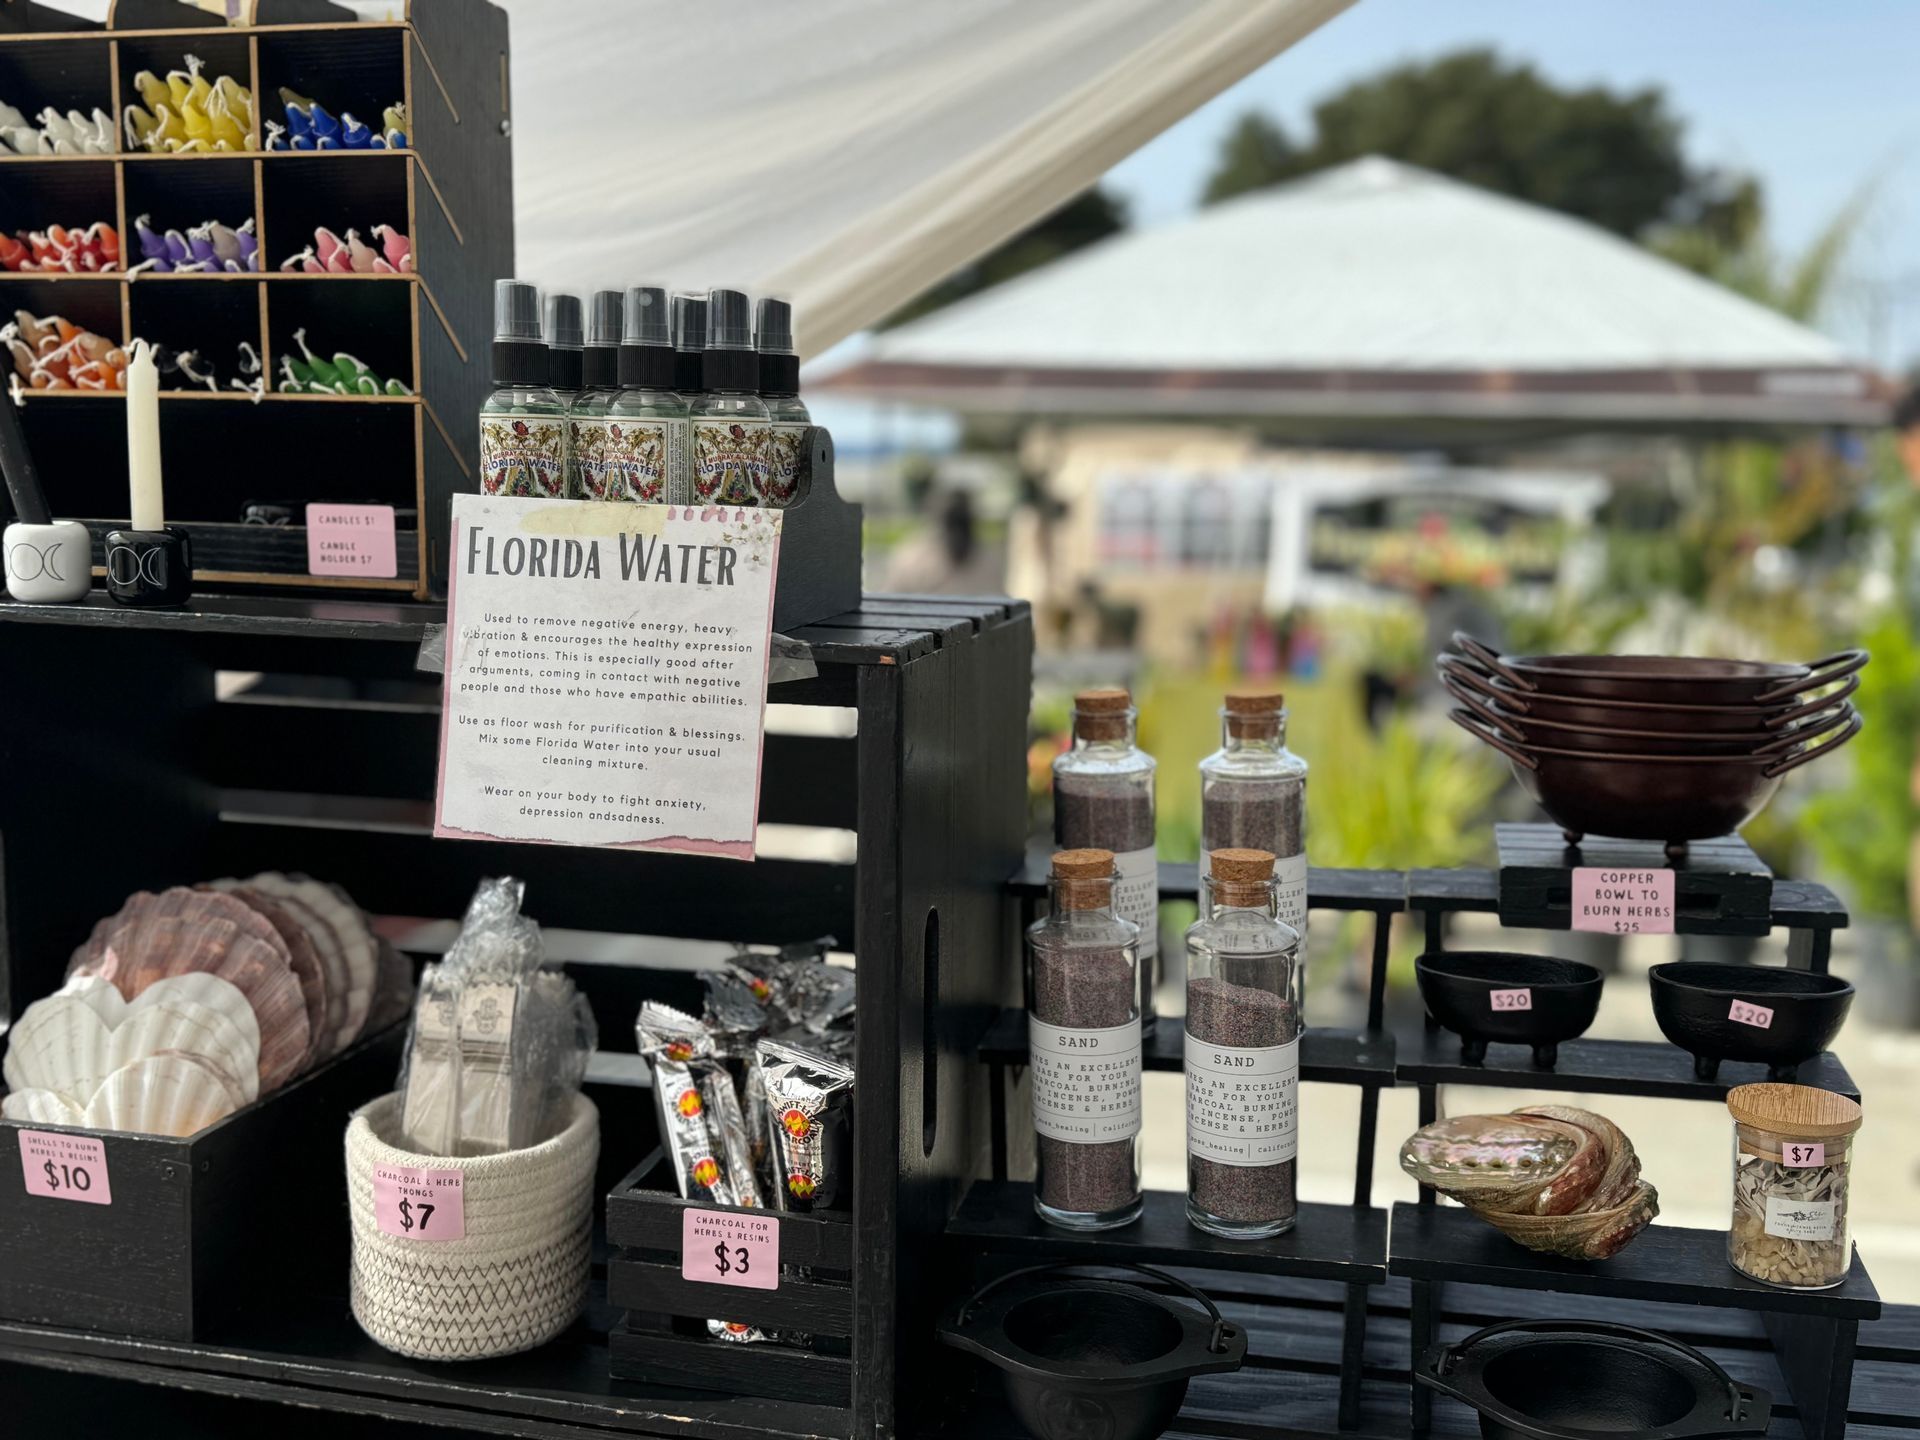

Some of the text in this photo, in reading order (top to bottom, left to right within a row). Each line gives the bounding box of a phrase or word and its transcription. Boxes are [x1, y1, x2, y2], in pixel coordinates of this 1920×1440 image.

[580, 461, 605, 473] WATE
[622, 461, 658, 478] WATER
[698, 461, 769, 476] FLORIDA WATE
[774, 466, 800, 480] FLOR
[318, 515, 361, 525] CANDLES
[320, 542, 356, 551] CANDLE
[320, 555, 356, 563] HOLDER
[484, 613, 733, 636] Used to remove negative energy, heavy
[462, 629, 753, 653] vibration & encourages the healthy expression
[478, 648, 734, 670] of emotions. This is especially good after
[469, 666, 741, 688] arguments, coming in contact with negative
[460, 682, 748, 706] people and those who have empathic abilities.
[459, 714, 745, 742] Use as floor wash for purification & blessings.
[479, 733, 721, 758] Mix some Florida Water into your usual
[542, 755, 648, 771] cleaning mixture.
[484, 785, 706, 811] Wear on your body to fight anxiety,
[519, 806, 665, 825] depression andsadness.
[1600, 873, 1654, 884] COPPER
[1595, 889, 1659, 900] BOWL TO
[1583, 905, 1670, 917] BURN HERBS
[1614, 921, 1640, 933] $25
[1059, 1036, 1099, 1048] SAND
[1057, 1062, 1071, 1071] AN
[1080, 1055, 1139, 1072] EXCELLENT
[1214, 1054, 1255, 1068] SAND
[1037, 1065, 1128, 1082] BASE FOR YOUR
[1088, 1078, 1135, 1092] BURNING
[1211, 1080, 1225, 1089] AN
[1236, 1076, 1295, 1092] EXCELLENT
[1047, 1091, 1106, 1103] INCENSE,
[1191, 1083, 1284, 1102] BASE FOR YOUR
[1101, 1100, 1133, 1112] HERBS
[1189, 1092, 1233, 1111] HARCOAL
[1244, 1098, 1292, 1112] BURNING
[1201, 1106, 1297, 1124] INCENSE, POWDE
[1256, 1120, 1289, 1133] HERBS
[28, 1137, 98, 1152] SHELLS TO BURN
[30, 1148, 56, 1157] HERBS
[69, 1153, 98, 1162] RESINS
[1791, 1146, 1815, 1164] $7
[44, 1159, 91, 1191] $10
[377, 1170, 421, 1185] CHARCOAL
[436, 1179, 460, 1187] HERB
[398, 1187, 434, 1197] THONGS
[399, 1197, 435, 1232] $7
[696, 1216, 768, 1231] CHARCOAL FOR
[694, 1228, 723, 1238] HERBS
[737, 1233, 770, 1243] RESINS
[714, 1241, 750, 1277] $3
